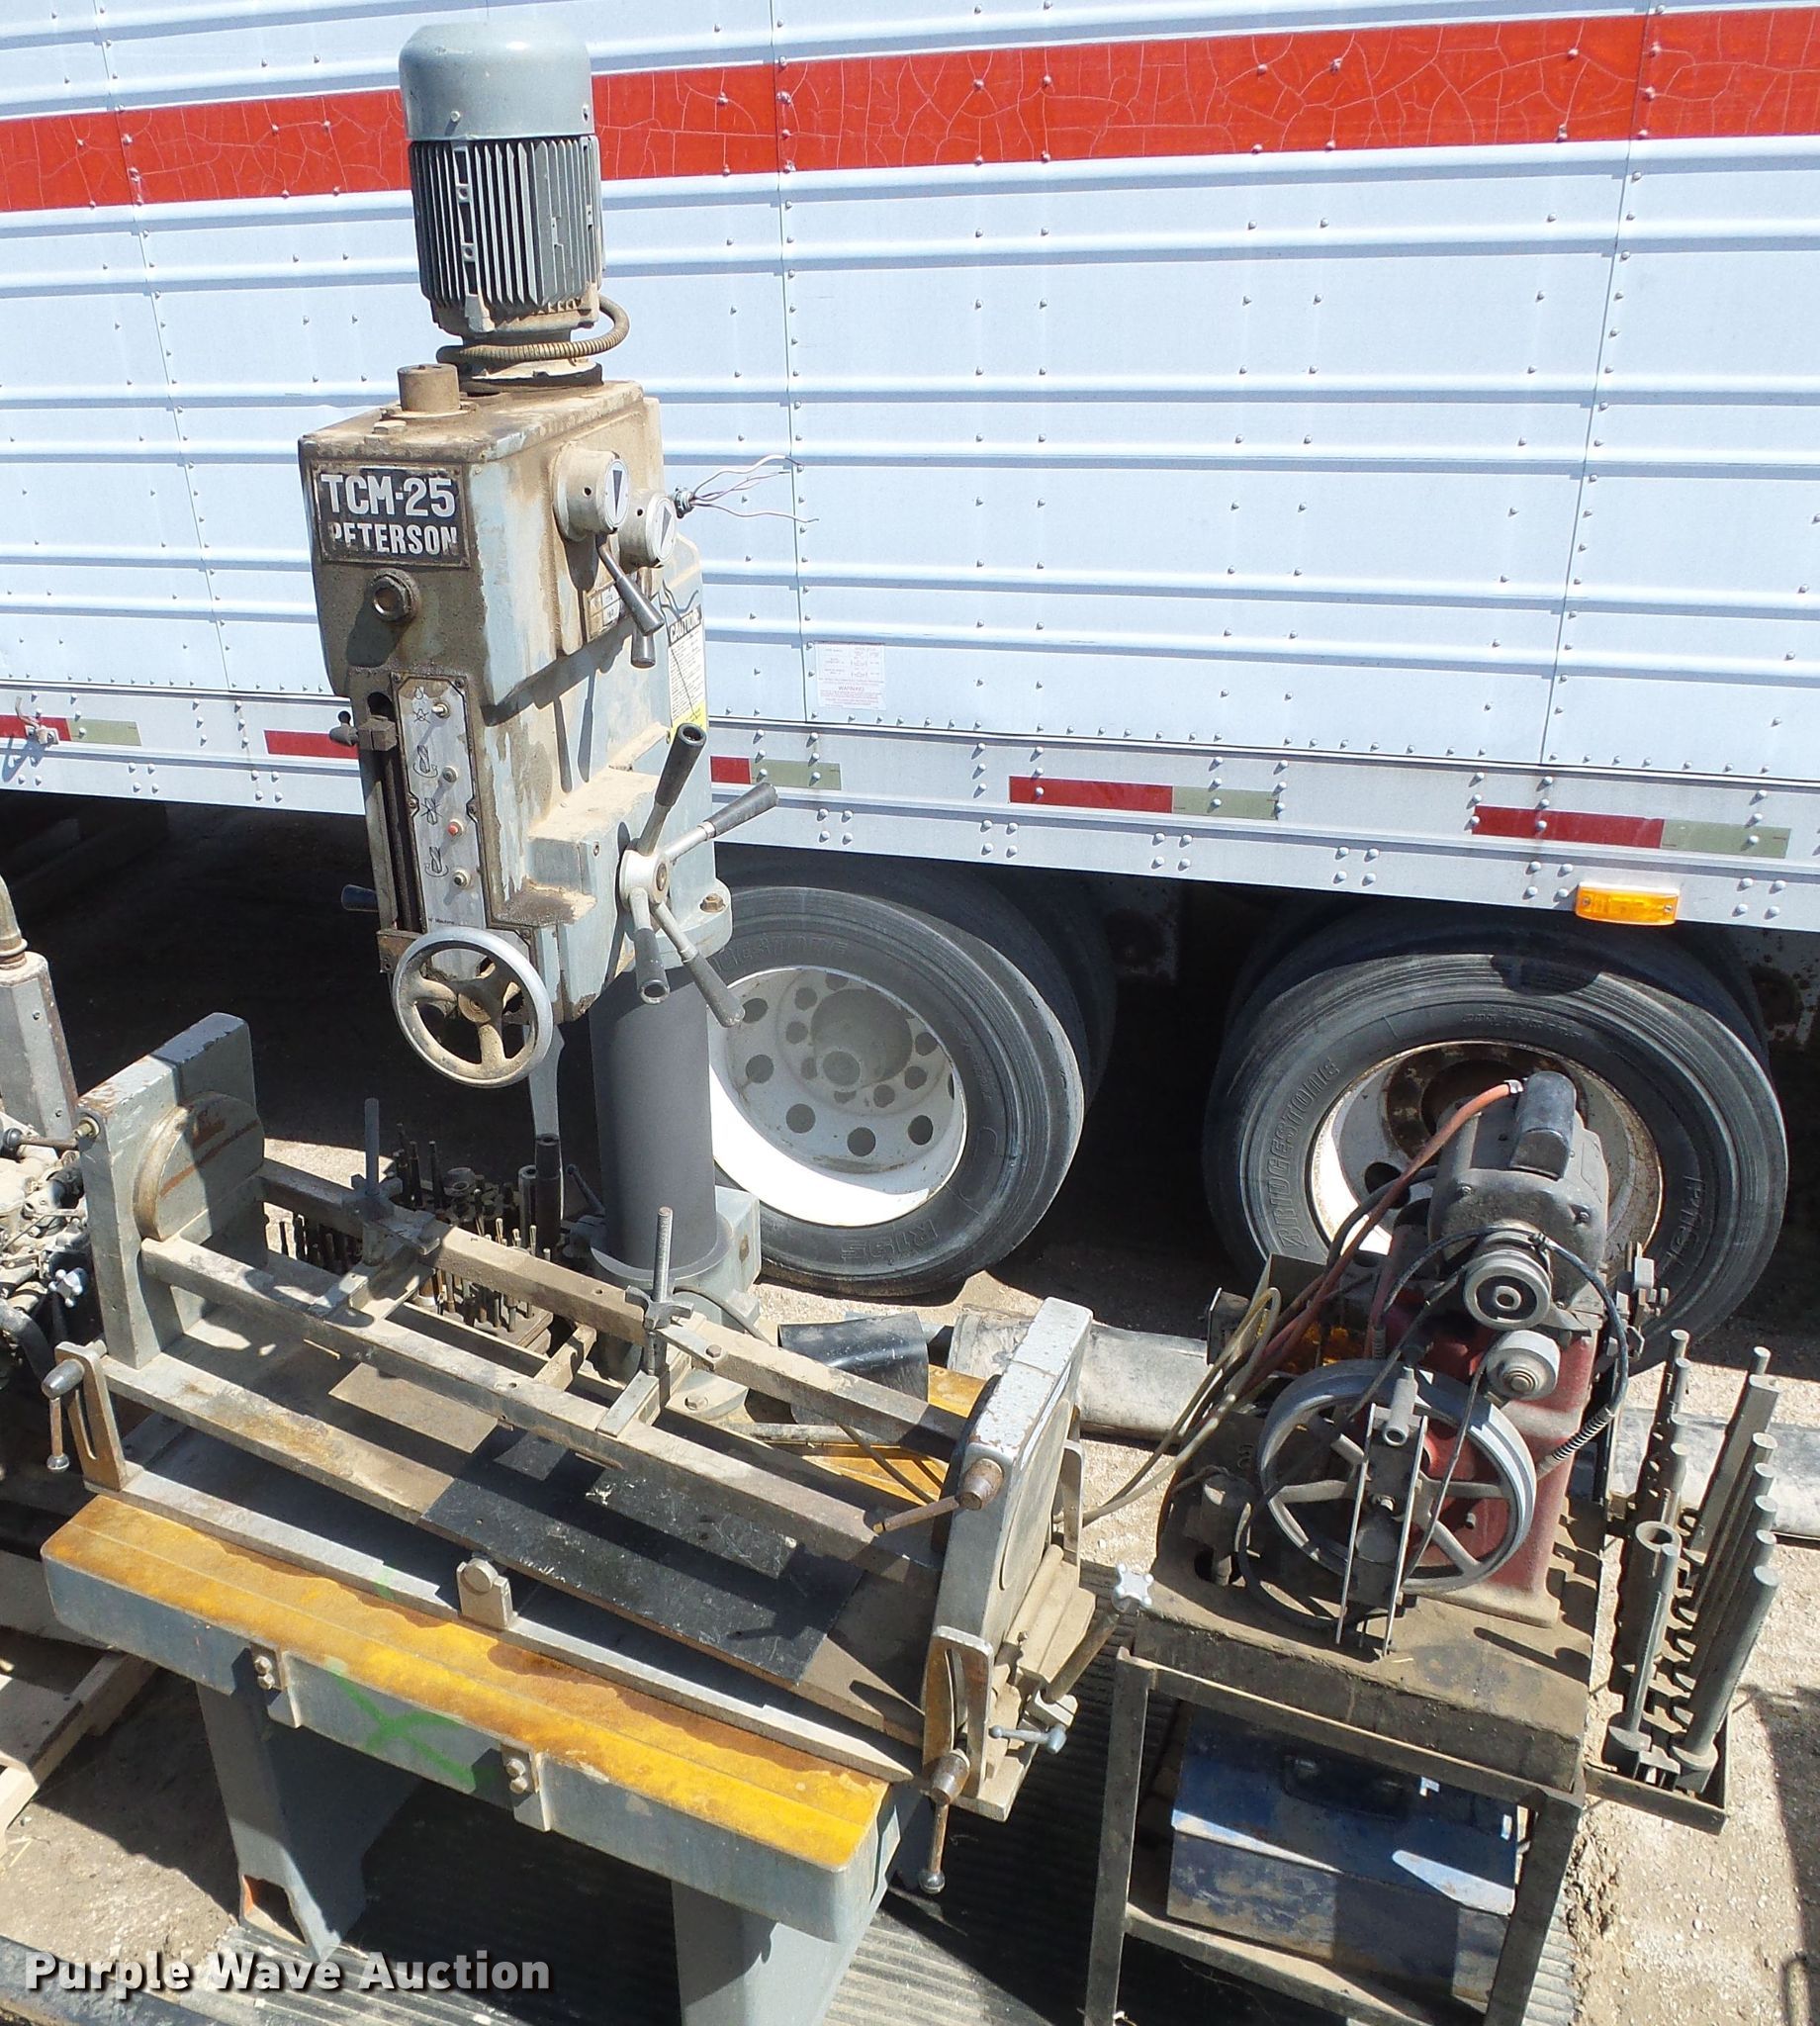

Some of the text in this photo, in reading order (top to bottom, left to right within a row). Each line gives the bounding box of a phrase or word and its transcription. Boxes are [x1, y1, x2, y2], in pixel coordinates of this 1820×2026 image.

[320, 474, 456, 517] TCM-25
[328, 521, 459, 556] PETERSON
[1267, 1056, 1340, 1248] BRIDGESTONE
